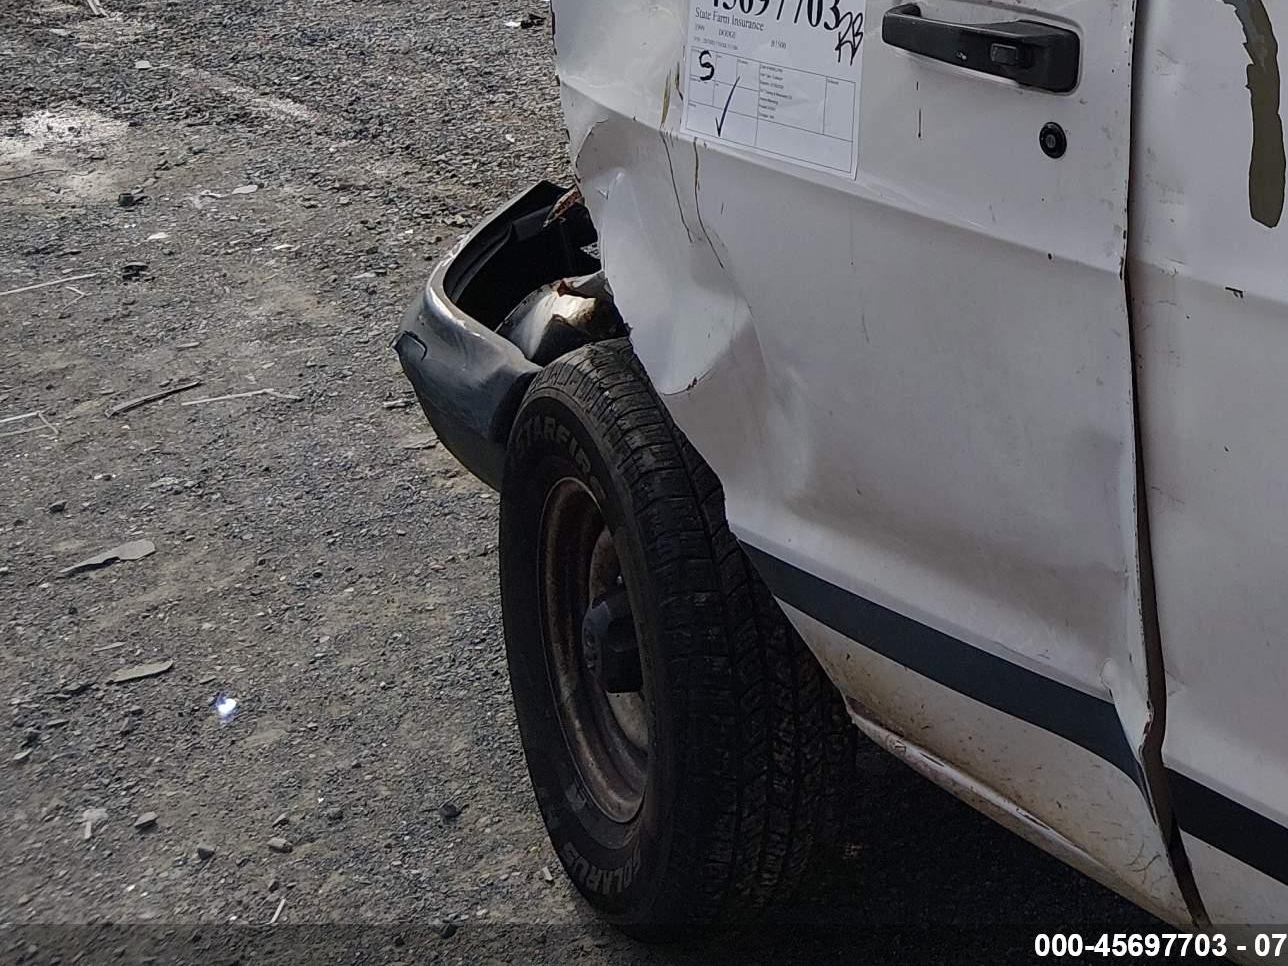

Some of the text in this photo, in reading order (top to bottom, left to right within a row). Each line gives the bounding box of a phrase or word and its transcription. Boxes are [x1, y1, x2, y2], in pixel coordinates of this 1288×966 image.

[696, 7, 765, 31] State Farm Insurance
